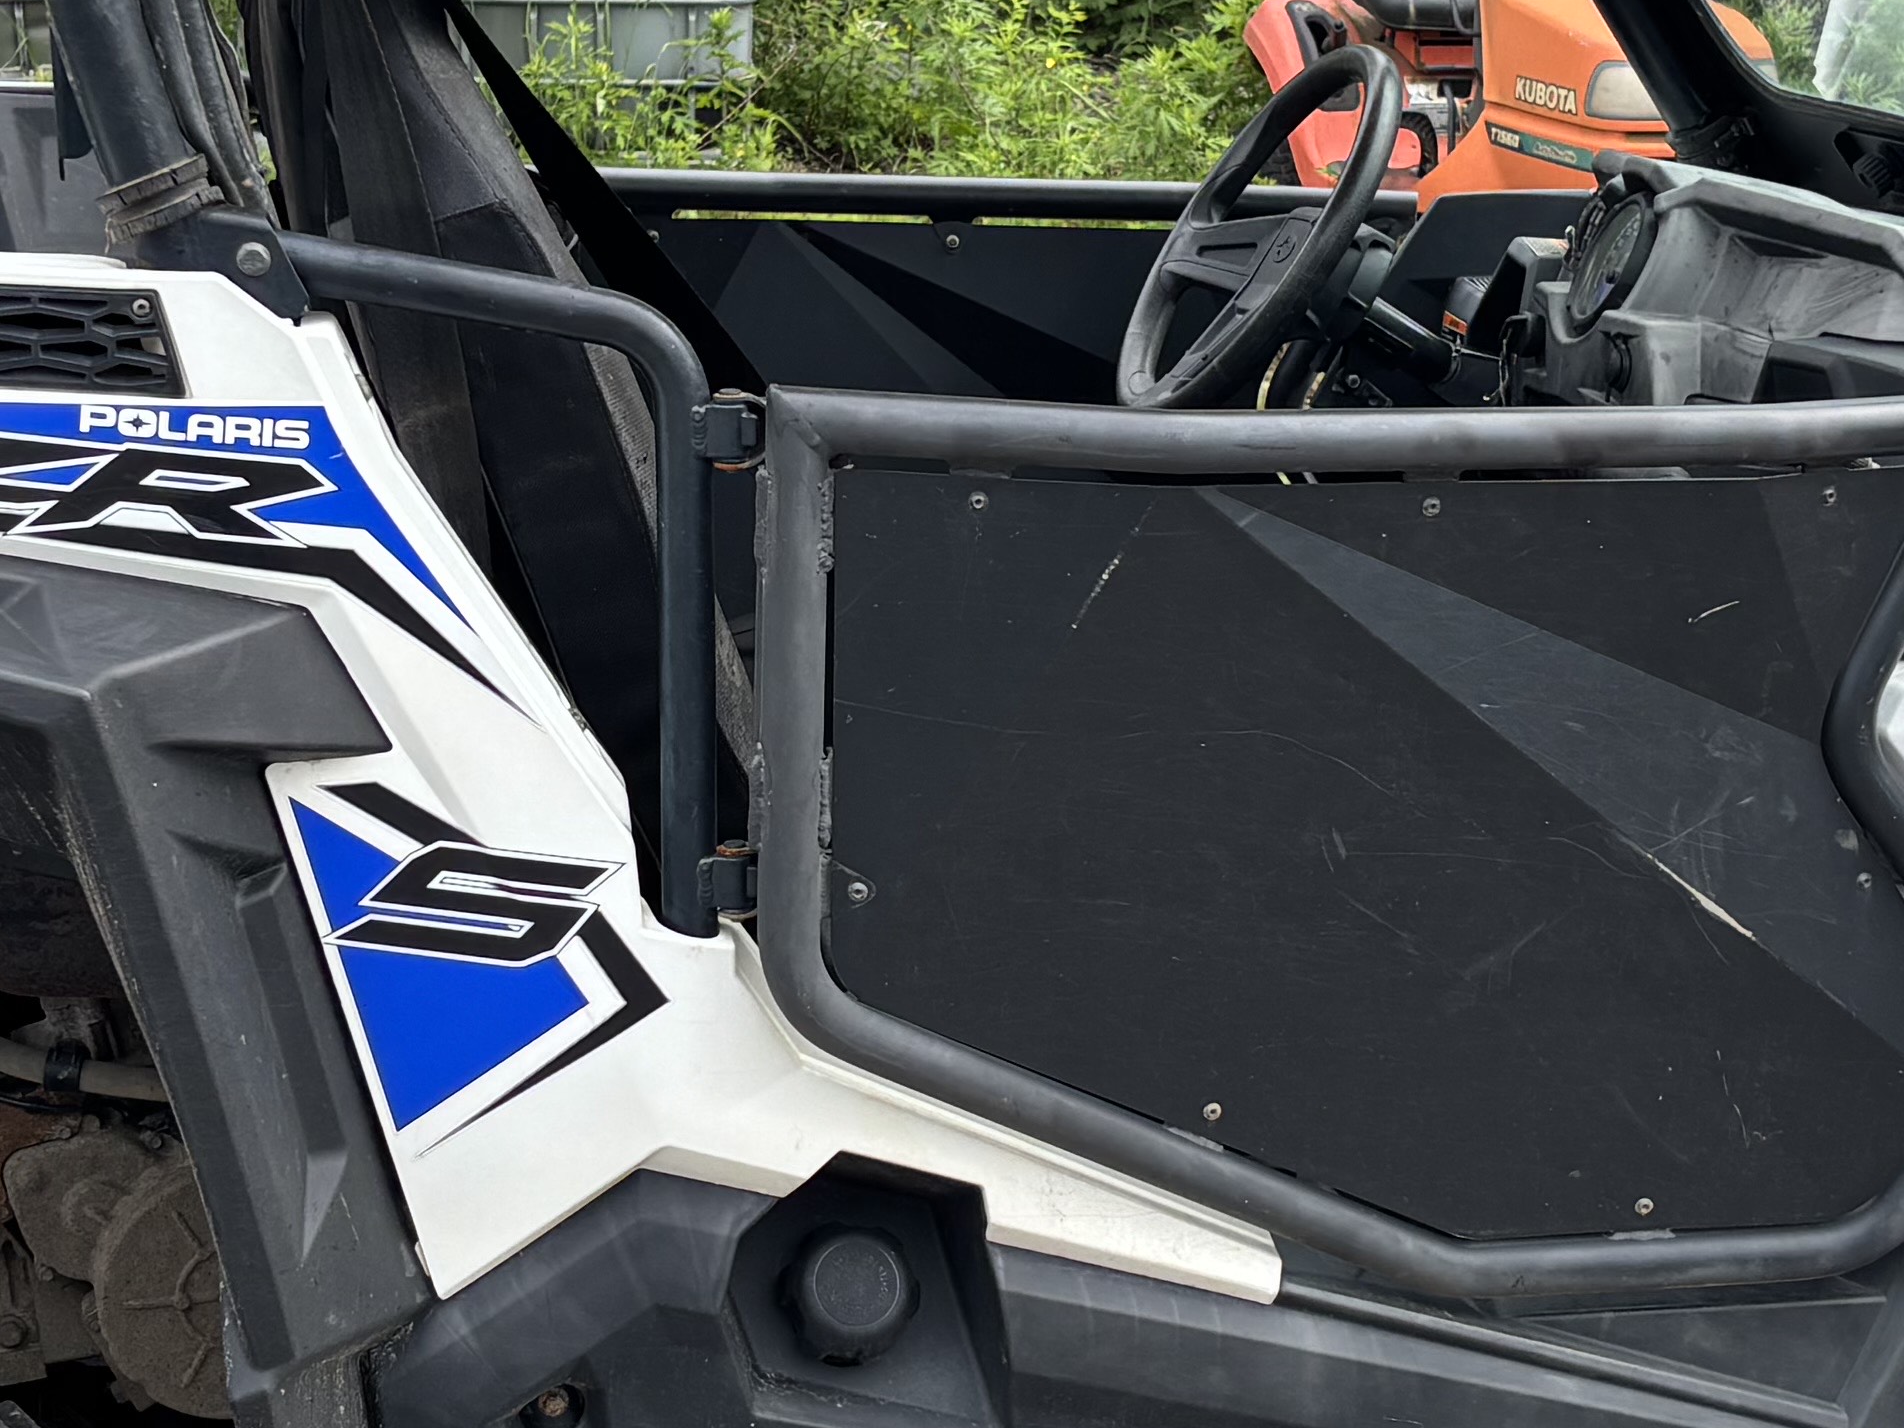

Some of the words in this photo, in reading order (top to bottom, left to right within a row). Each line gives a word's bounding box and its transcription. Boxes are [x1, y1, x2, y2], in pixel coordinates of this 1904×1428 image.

[1515, 75, 1578, 116] KUBOTA
[79, 404, 310, 450] POLARIS
[322, 840, 627, 968] S
